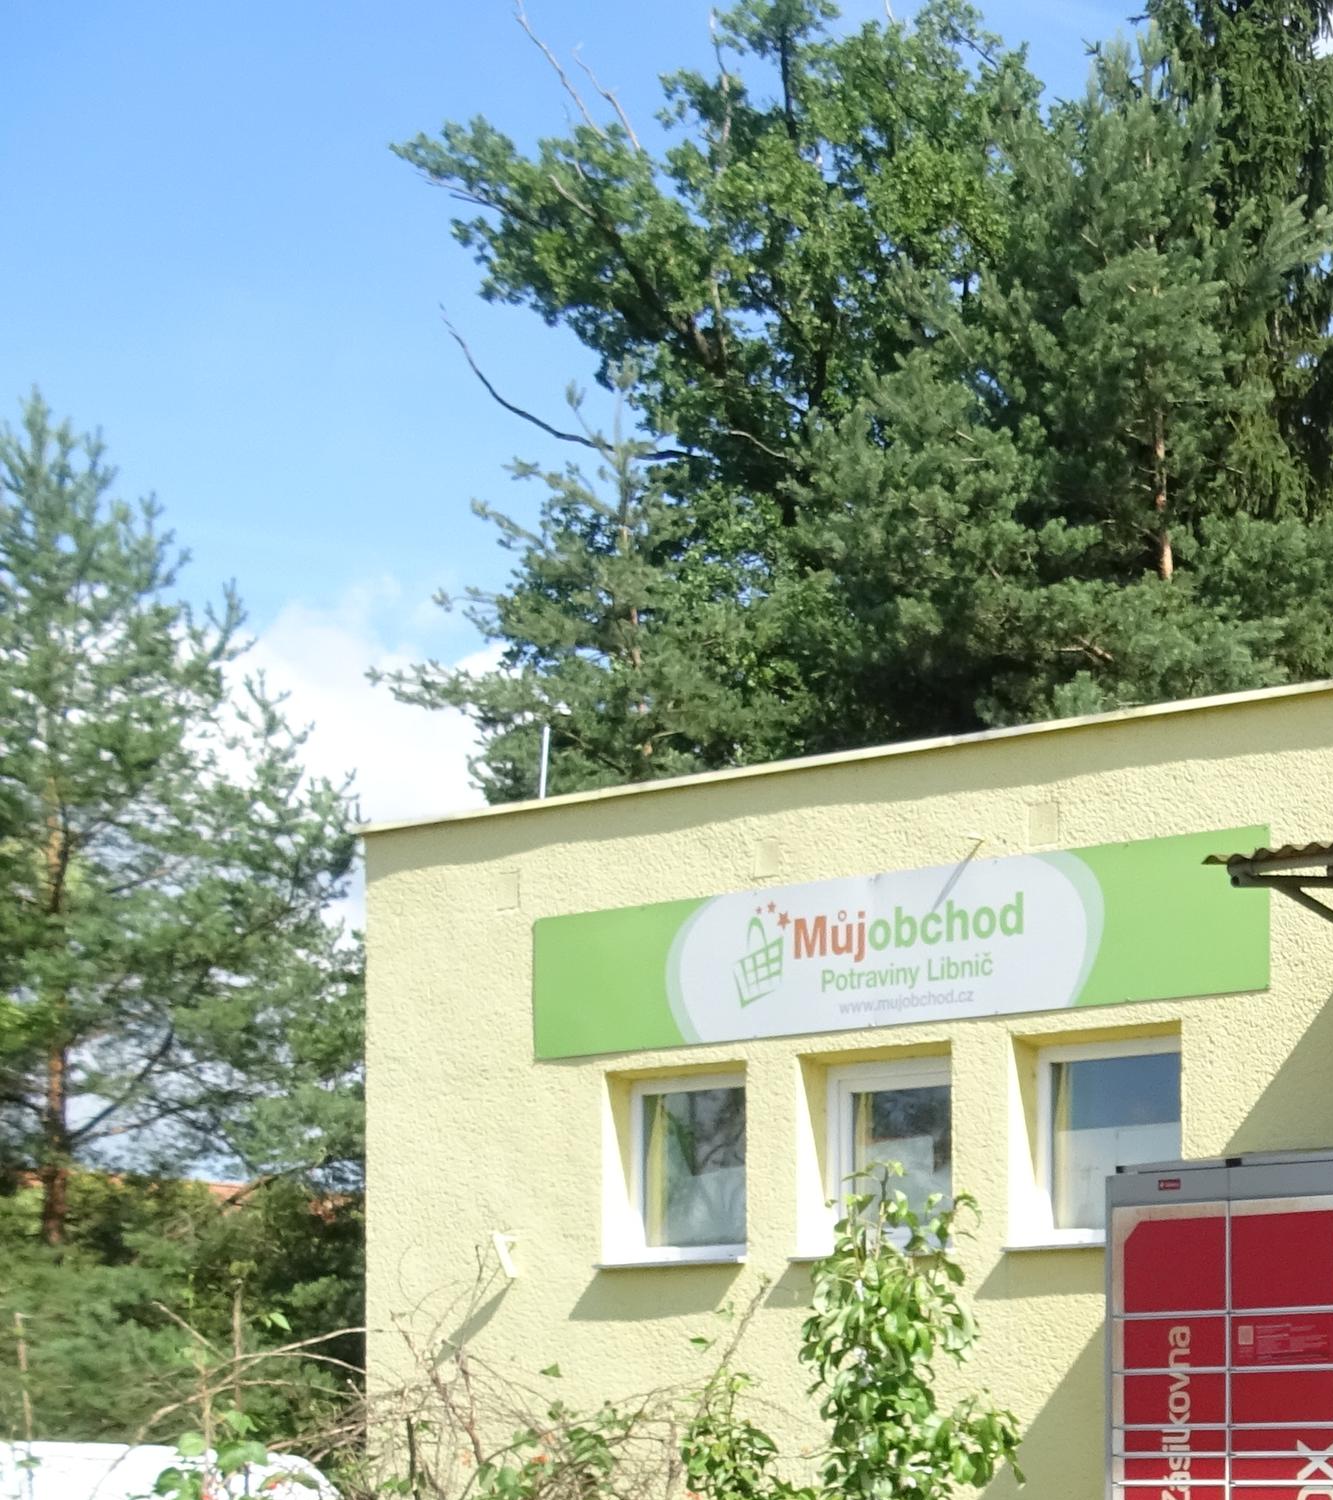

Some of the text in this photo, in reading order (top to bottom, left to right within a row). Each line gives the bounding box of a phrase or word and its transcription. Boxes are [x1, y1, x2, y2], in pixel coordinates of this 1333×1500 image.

[793, 892, 1024, 963] Můjobchod
[821, 952, 994, 992] Potraviny Libnič
